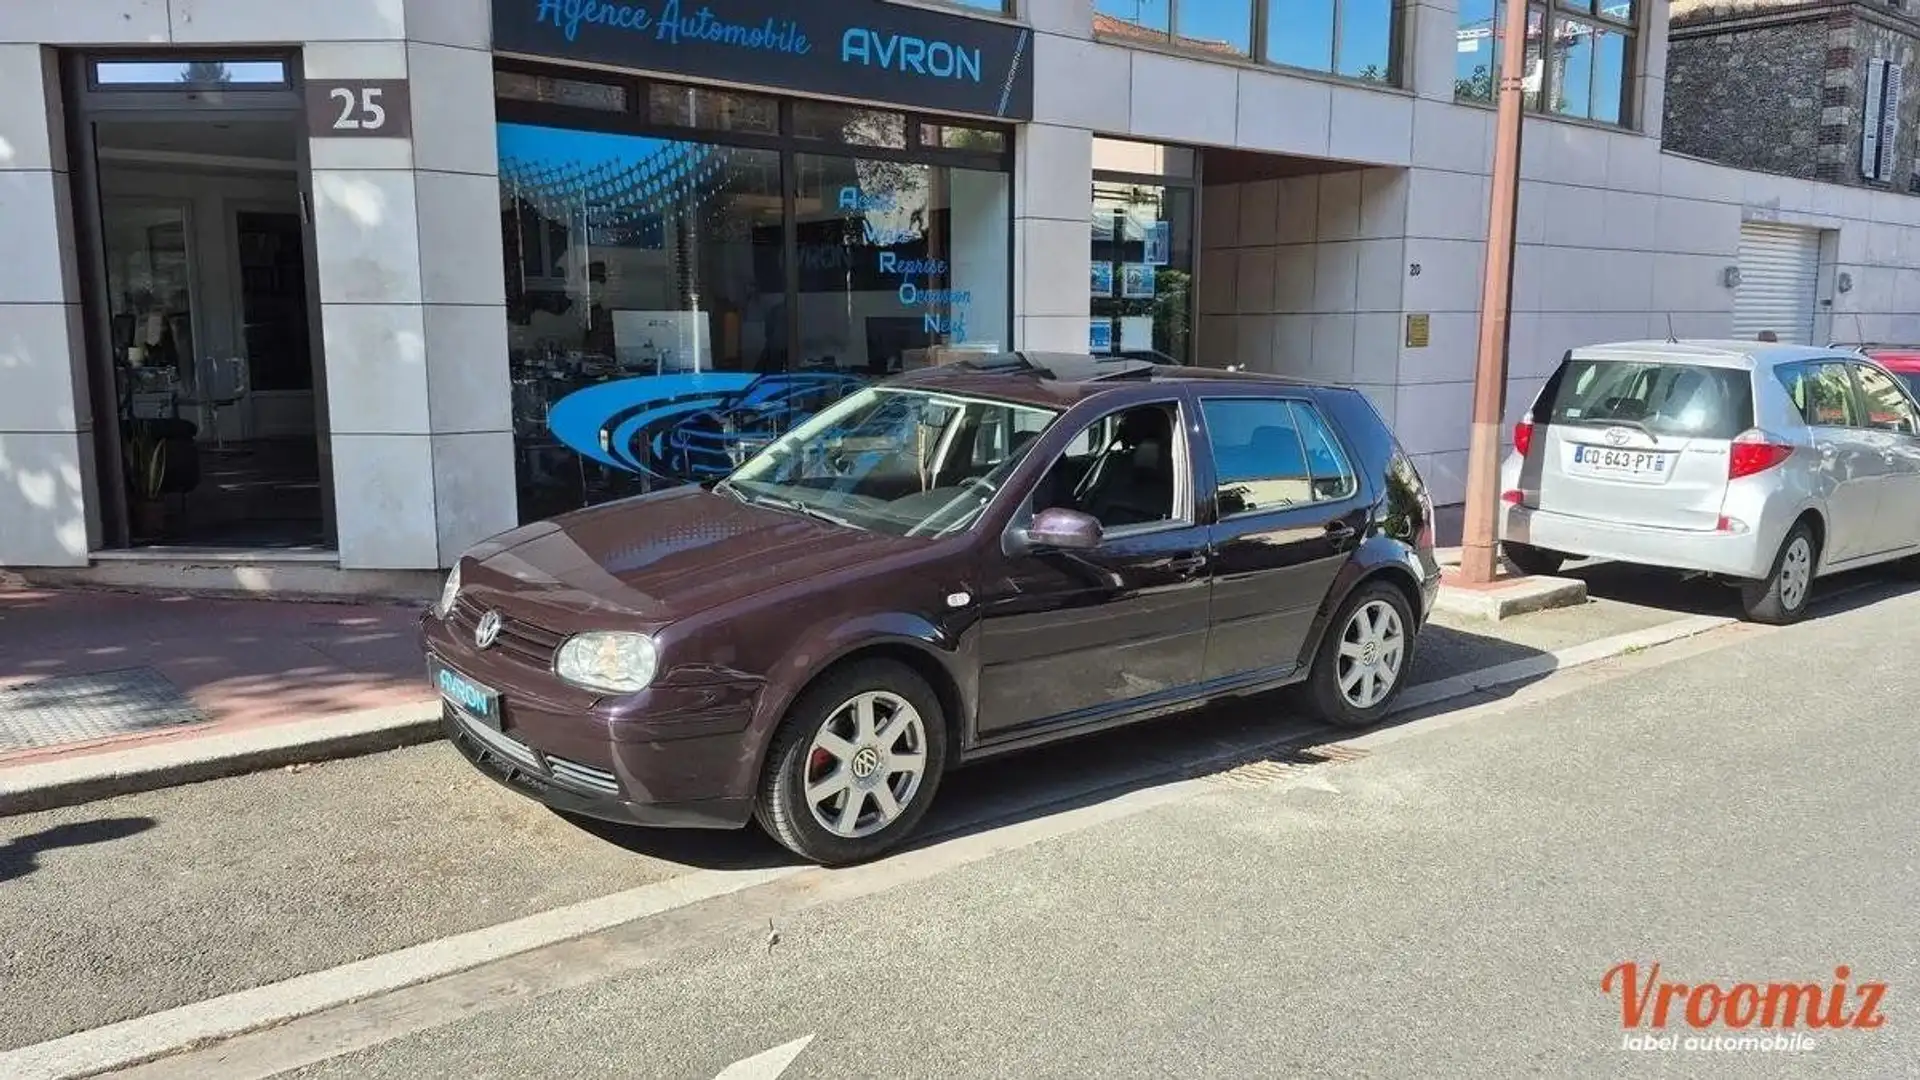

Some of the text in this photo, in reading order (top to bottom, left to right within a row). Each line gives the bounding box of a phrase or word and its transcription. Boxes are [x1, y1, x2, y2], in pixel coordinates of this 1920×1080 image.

[537, 0, 812, 54] Agence Automobile
[842, 27, 981, 83] AVRON
[330, 87, 386, 130] 25
[440, 668, 488, 715] AVRON
